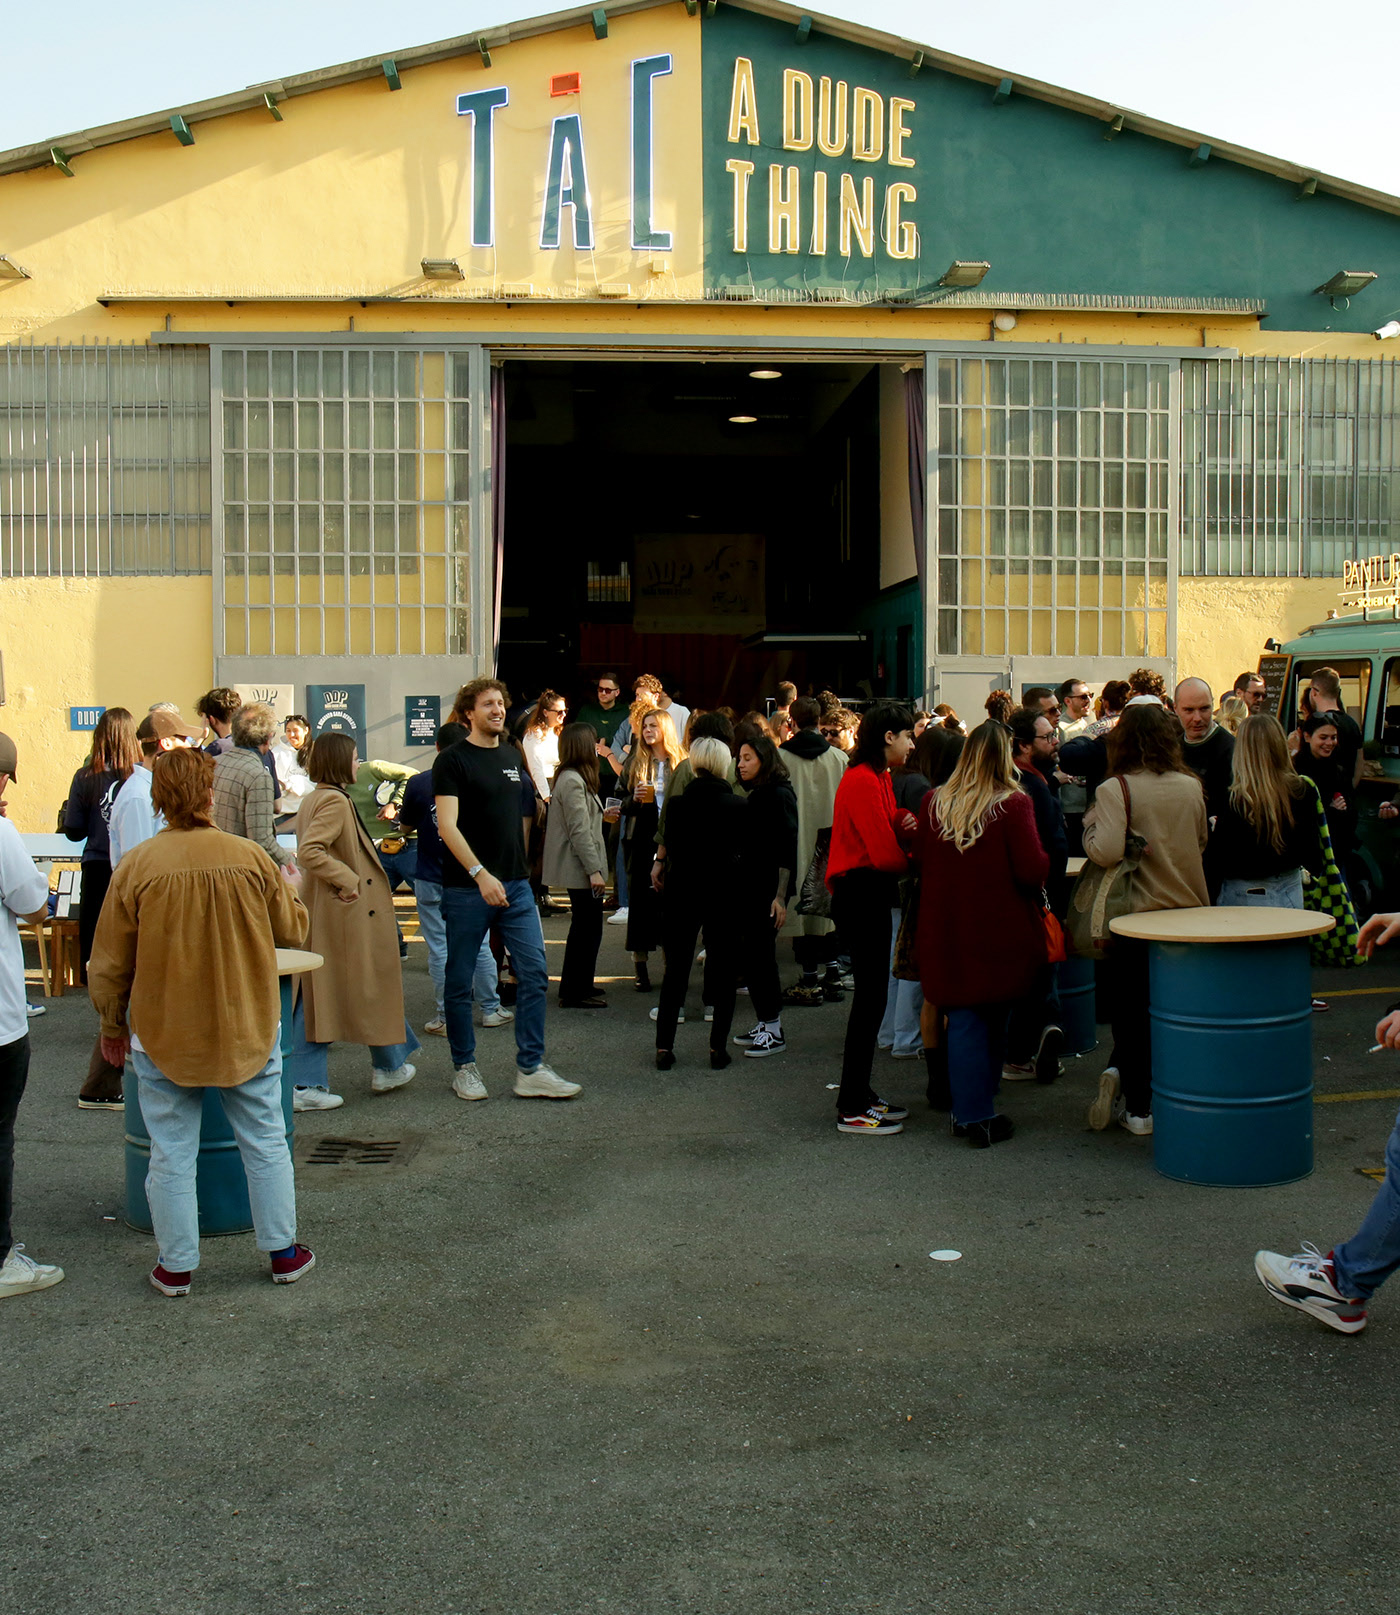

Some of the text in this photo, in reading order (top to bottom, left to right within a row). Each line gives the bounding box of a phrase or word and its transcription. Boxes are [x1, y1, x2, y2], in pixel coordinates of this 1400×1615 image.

[726, 56, 917, 168] A DUDE
[725, 158, 918, 261] THING
[323, 690, 348, 704] DDP
